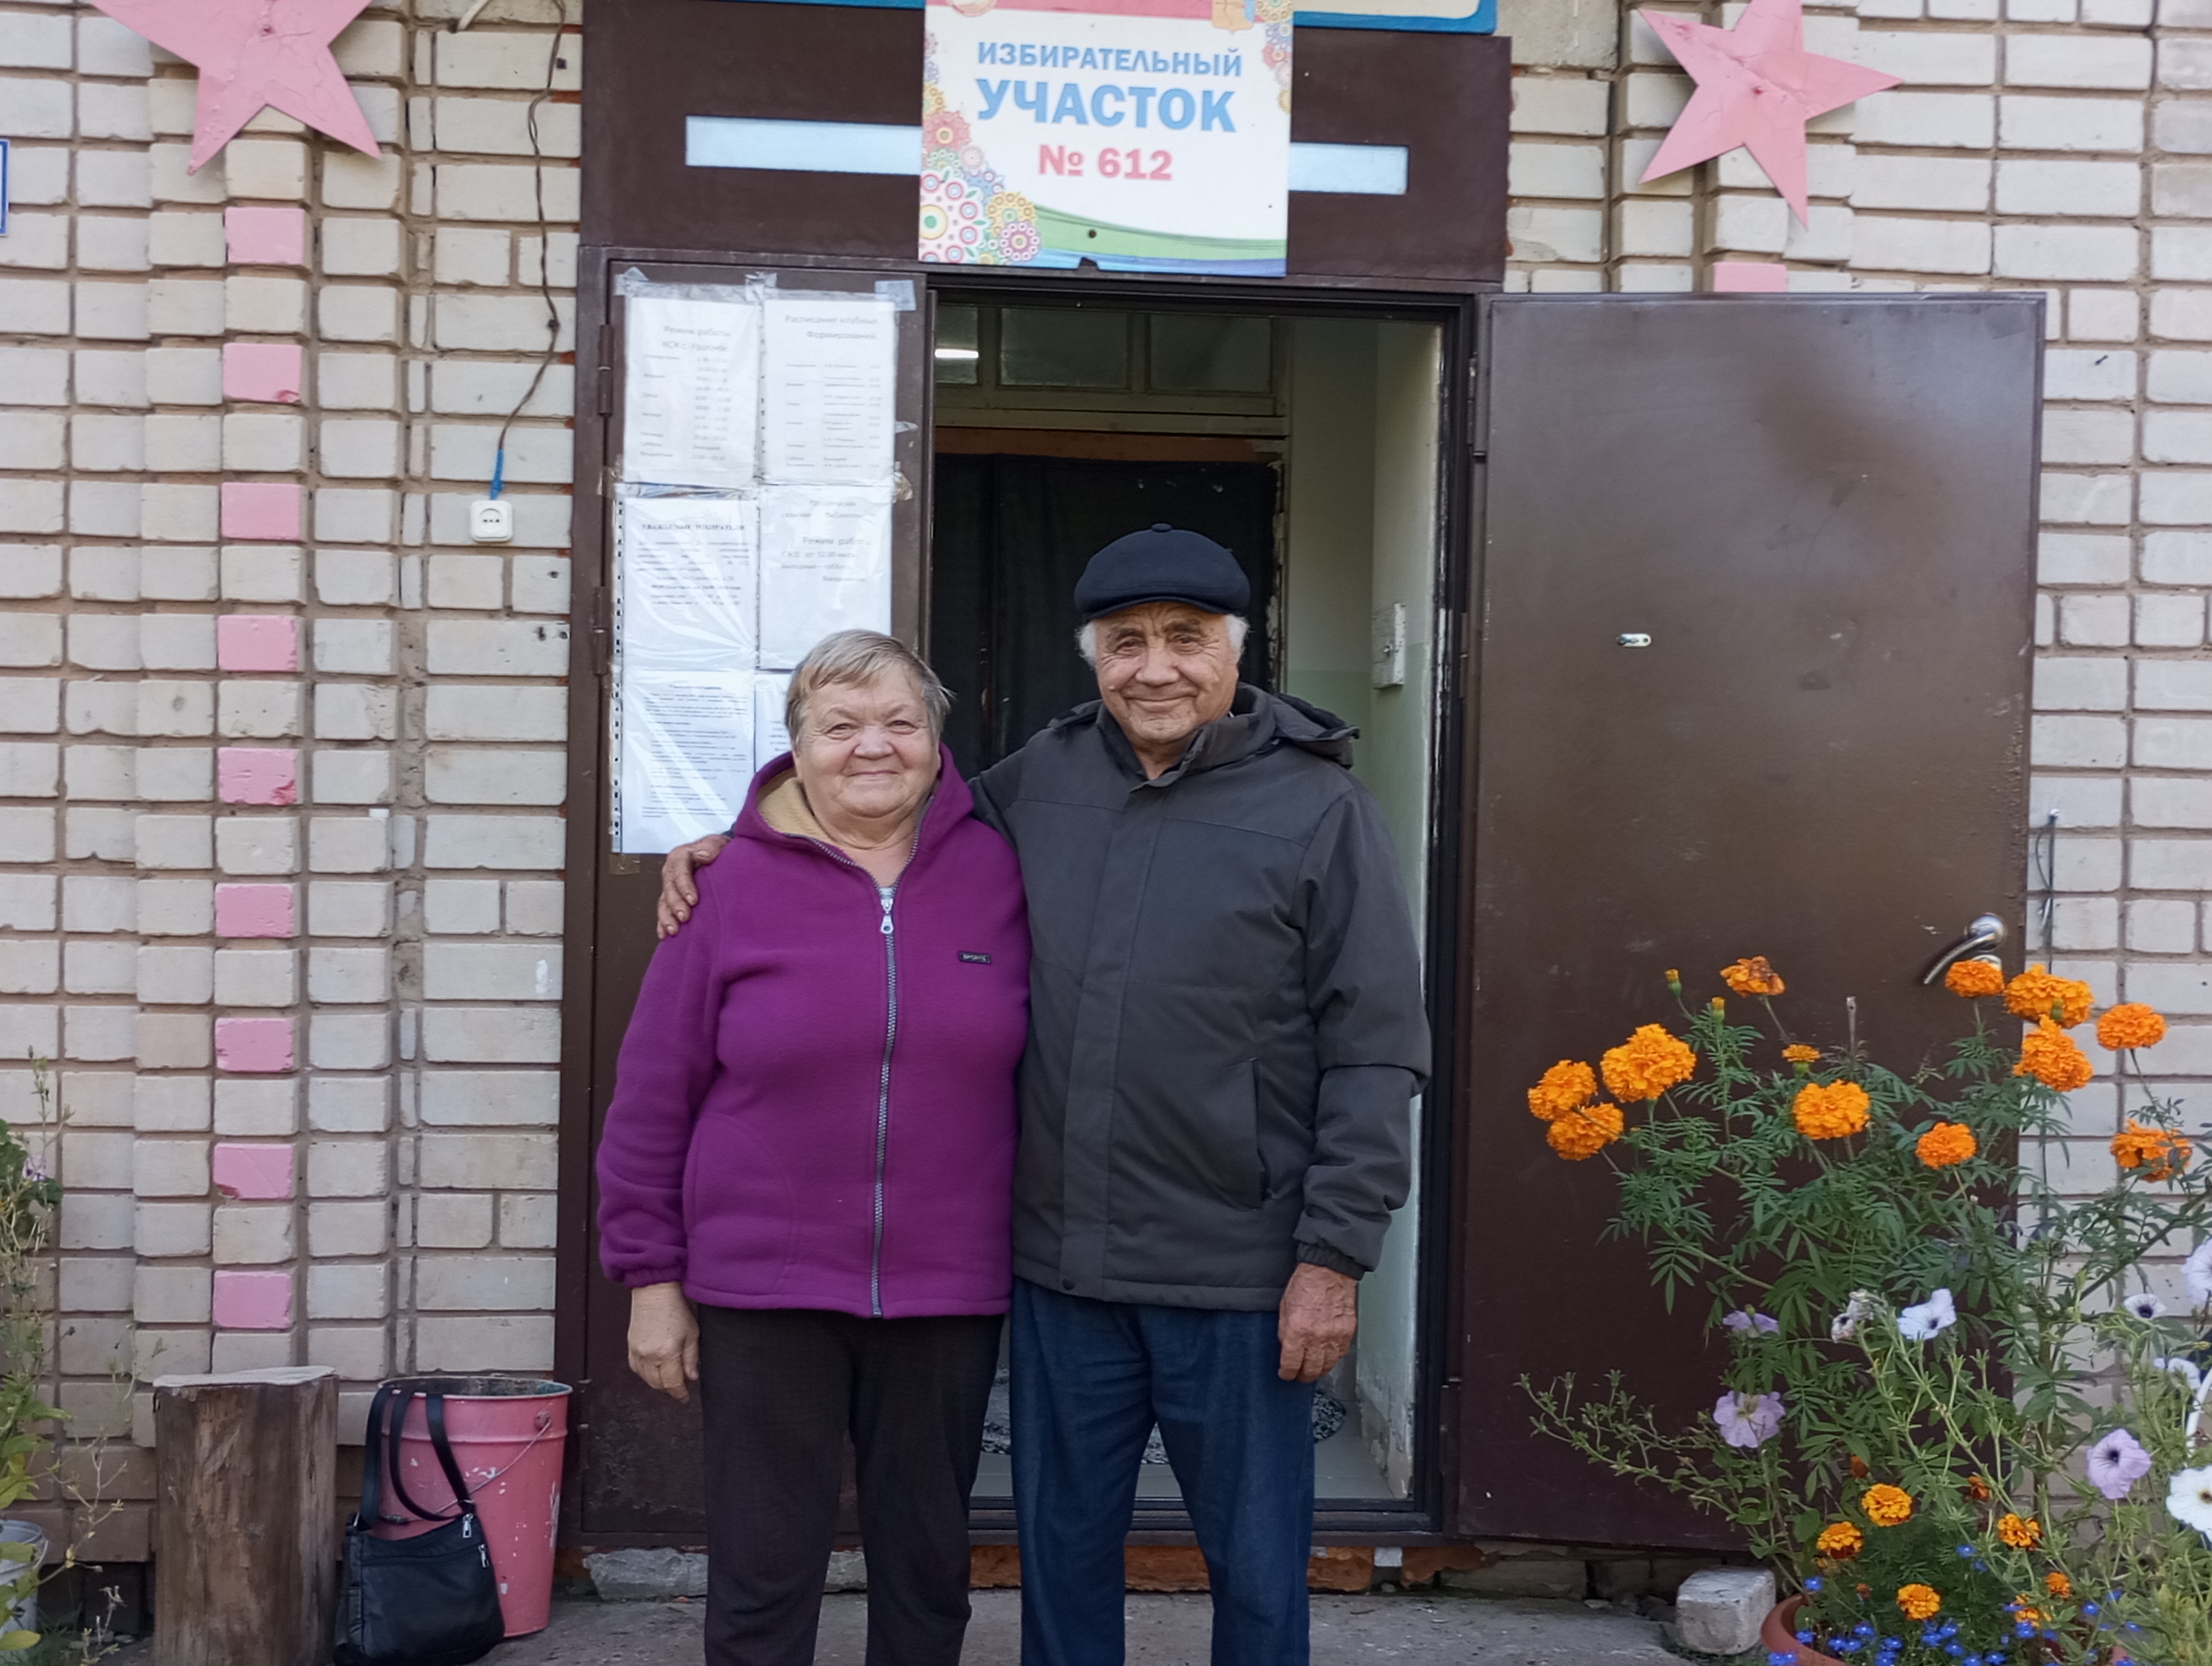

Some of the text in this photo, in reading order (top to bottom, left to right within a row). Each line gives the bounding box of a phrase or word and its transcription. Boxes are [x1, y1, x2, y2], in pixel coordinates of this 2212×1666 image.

[977, 42, 1242, 76] ИЗБИРАТЕЛЬНЫЙ
[975, 78, 1237, 132] УЧАСТОК
[1038, 144, 1173, 181] № 612
